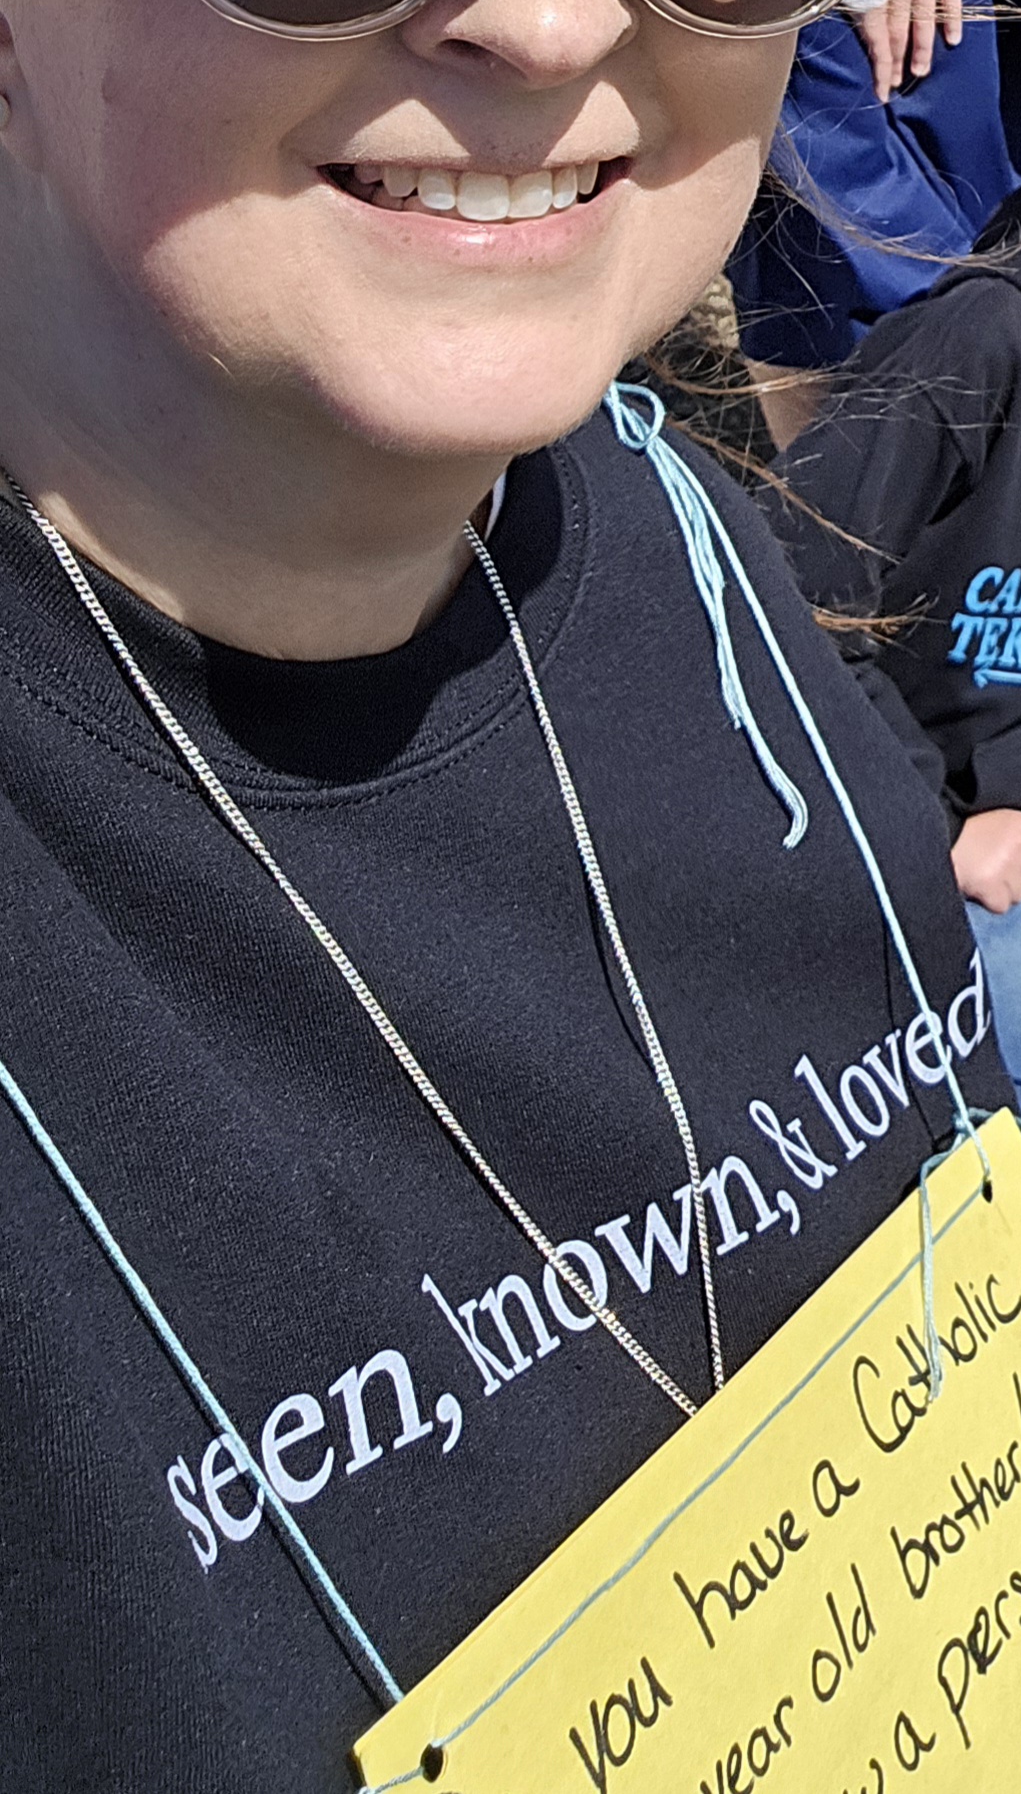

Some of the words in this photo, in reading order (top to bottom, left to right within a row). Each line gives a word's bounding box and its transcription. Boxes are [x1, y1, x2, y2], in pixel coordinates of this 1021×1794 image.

[794, 957, 993, 1161] loved
[568, 1656, 674, 1794] you
[674, 1510, 809, 1649] have
[812, 1458, 861, 1518] a
[811, 1563, 877, 1703] old
[893, 1710, 937, 1772] a
